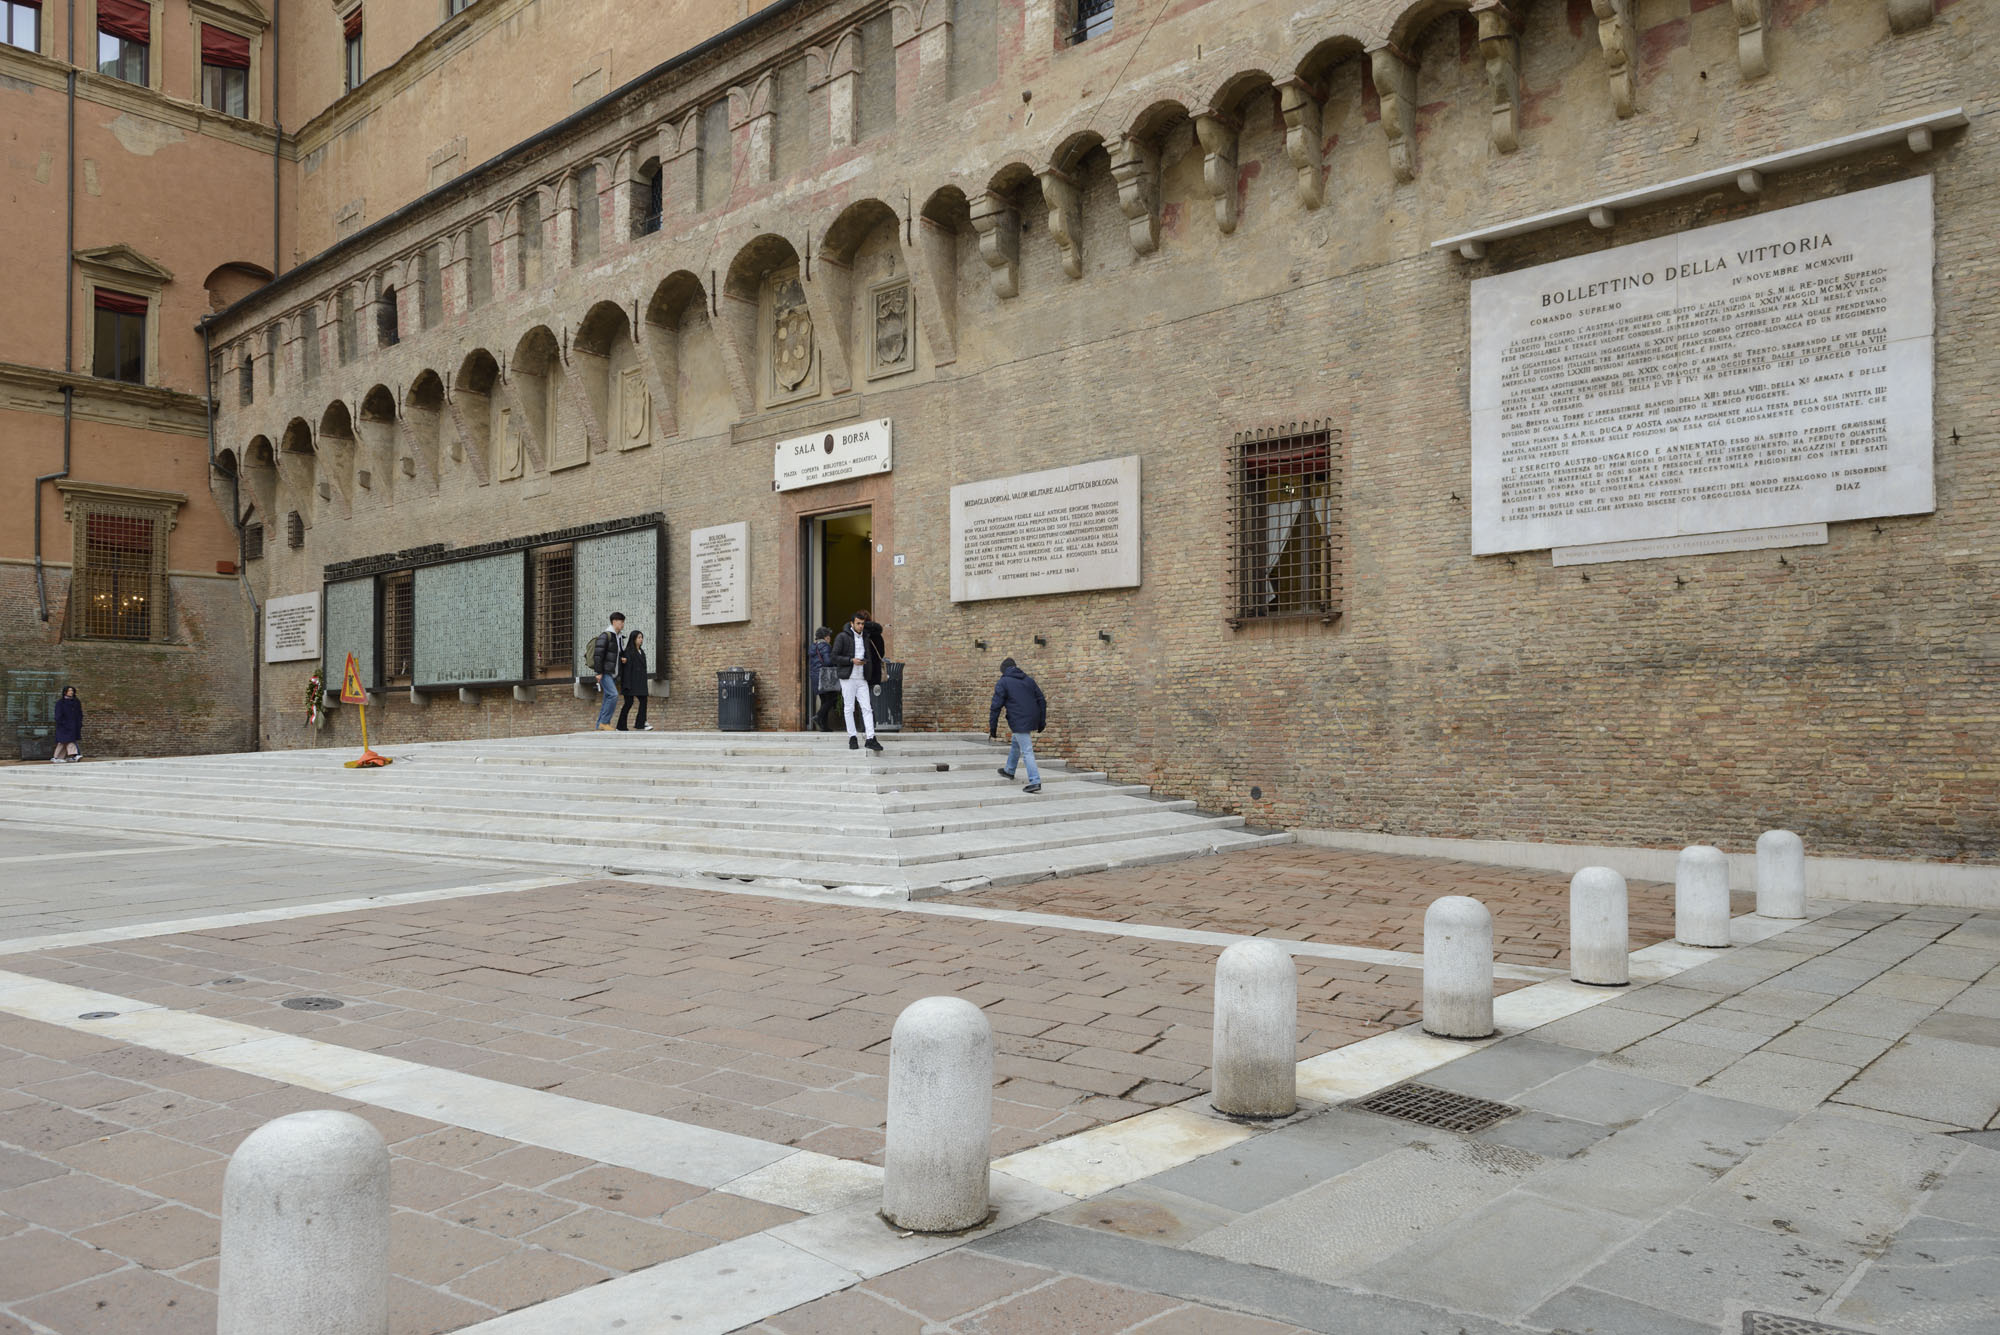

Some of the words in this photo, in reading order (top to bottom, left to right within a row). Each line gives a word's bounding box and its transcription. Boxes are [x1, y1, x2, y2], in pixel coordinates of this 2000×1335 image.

[1541, 270, 1654, 307] BOLLETTINO
[1665, 255, 1726, 281] DELLA
[1737, 232, 1833, 266] VITTORIA
[1731, 276, 1741, 285] IV
[1746, 265, 1798, 282] NOVEMBRE
[1805, 254, 1854, 270] MCMXVIII
[1708, 297, 1725, 308] ALTA
[1728, 292, 1751, 304] GUIDA
[1754, 290, 1763, 299] DI
[1799, 275, 1839, 290] RE-DUCE
[1748, 300, 1754, 308] IL
[1759, 295, 1781, 306] XXIV
[1784, 288, 1816, 302] MAGGIO
[1819, 280, 1856, 295] MCMXV
[1868, 274, 1887, 286] CON
[1529, 311, 1572, 326] COMANDO
[1579, 301, 1622, 316] SUPREMO
[1702, 325, 1730, 337] SCORSO
[1734, 319, 1766, 331] OTTOBRE
[1770, 316, 1781, 324] ED
[1785, 312, 1803, 322] ALLA
[1807, 307, 1830, 318] QUALE
[1835, 296, 1887, 313] PRENDEVANO
[1718, 333, 1732, 342] UNA
[1735, 320, 1802, 339] CZECO-SLOVACCA
[1806, 318, 1816, 326] ED
[1820, 315, 1831, 324] UN
[1834, 305, 1887, 321] REGGIMENTO
[1721, 313, 1732, 322] ED
[1735, 304, 1778, 319] ASPRISSIMA
[1782, 301, 1797, 310] PER
[1801, 297, 1818, 306] XLI
[1701, 353, 1728, 364] ARMATA
[1732, 351, 1742, 359] SU
[1781, 336, 1826, 351] SBARRANDO
[1831, 334, 1840, 342] LE
[1845, 331, 1857, 340] VIE
[1861, 326, 1887, 337] DELLA
[1720, 355, 1764, 369] OCCIDENTE
[1771, 350, 1794, 361] DALLE
[1801, 344, 1831, 356] TRUPPE
[1838, 338, 1865, 350] DELLA
[1717, 363, 1771, 378] DETERMINATO
[1777, 359, 1794, 368] IERI
[1798, 356, 1809, 365] LO
[1814, 350, 1851, 362] SFACELO
[1856, 344, 1887, 355] TOTALE
[1722, 387, 1745, 397] DELLA
[1770, 379, 1794, 390] DELLA
[1814, 371, 1843, 383] ARMATA
[1859, 364, 1886, 376] DELLE
[1694, 408, 1740, 421] RAPIDAMENTE
[1745, 404, 1762, 414] ALLA
[1766, 400, 1788, 411] TESTA
[1792, 396, 1818, 407] DELLA
[1823, 393, 1838, 402] SUA
[1841, 388, 1871, 400] INVITTA
[1712, 396, 1741, 406] NEMICO
[1725, 409, 1793, 425] GLORIOSAMENTE
[1867, 395, 1887, 405] CHE
[794, 442, 815, 455] SALA
[842, 430, 869, 445] BORSA
[1730, 435, 1749, 445] ESSO
[1754, 433, 1764, 442] HA
[1768, 429, 1798, 440] SUBITO
[1803, 424, 1836, 435] PERDITE
[1841, 417, 1887, 430] GRAVISSIME
[1792, 437, 1803, 445] HA
[1808, 431, 1845, 443] PERDUTO
[783, 469, 796, 478] PIAZZA
[801, 465, 819, 474] COPERTA
[823, 459, 847, 470] BIBLIOTECA
[852, 453, 877, 464] MEDIATECA
[1688, 460, 1748, 474] TRECENTOMILA
[1754, 454, 1801, 466] PRIGIONIERI
[1806, 451, 1824, 460] CON
[1830, 447, 1858, 457] INTERI
[1864, 443, 1888, 453] STATI
[1707, 456, 1721, 464] PER
[1725, 452, 1753, 462] INTERO
[1766, 448, 1786, 456] SUOI
[1790, 441, 1836, 454] MAGAZZINI
[822, 466, 852, 477] ARCHEOLOGICI
[1730, 481, 1744, 489] DEL
[1749, 477, 1778, 487] MONDO
[1782, 471, 1827, 483] RISALGONO
[1843, 464, 1888, 476] DISORDINE
[1834, 481, 1861, 491] DIAZ
[1700, 488, 1751, 500] ORGOGLIOSA
